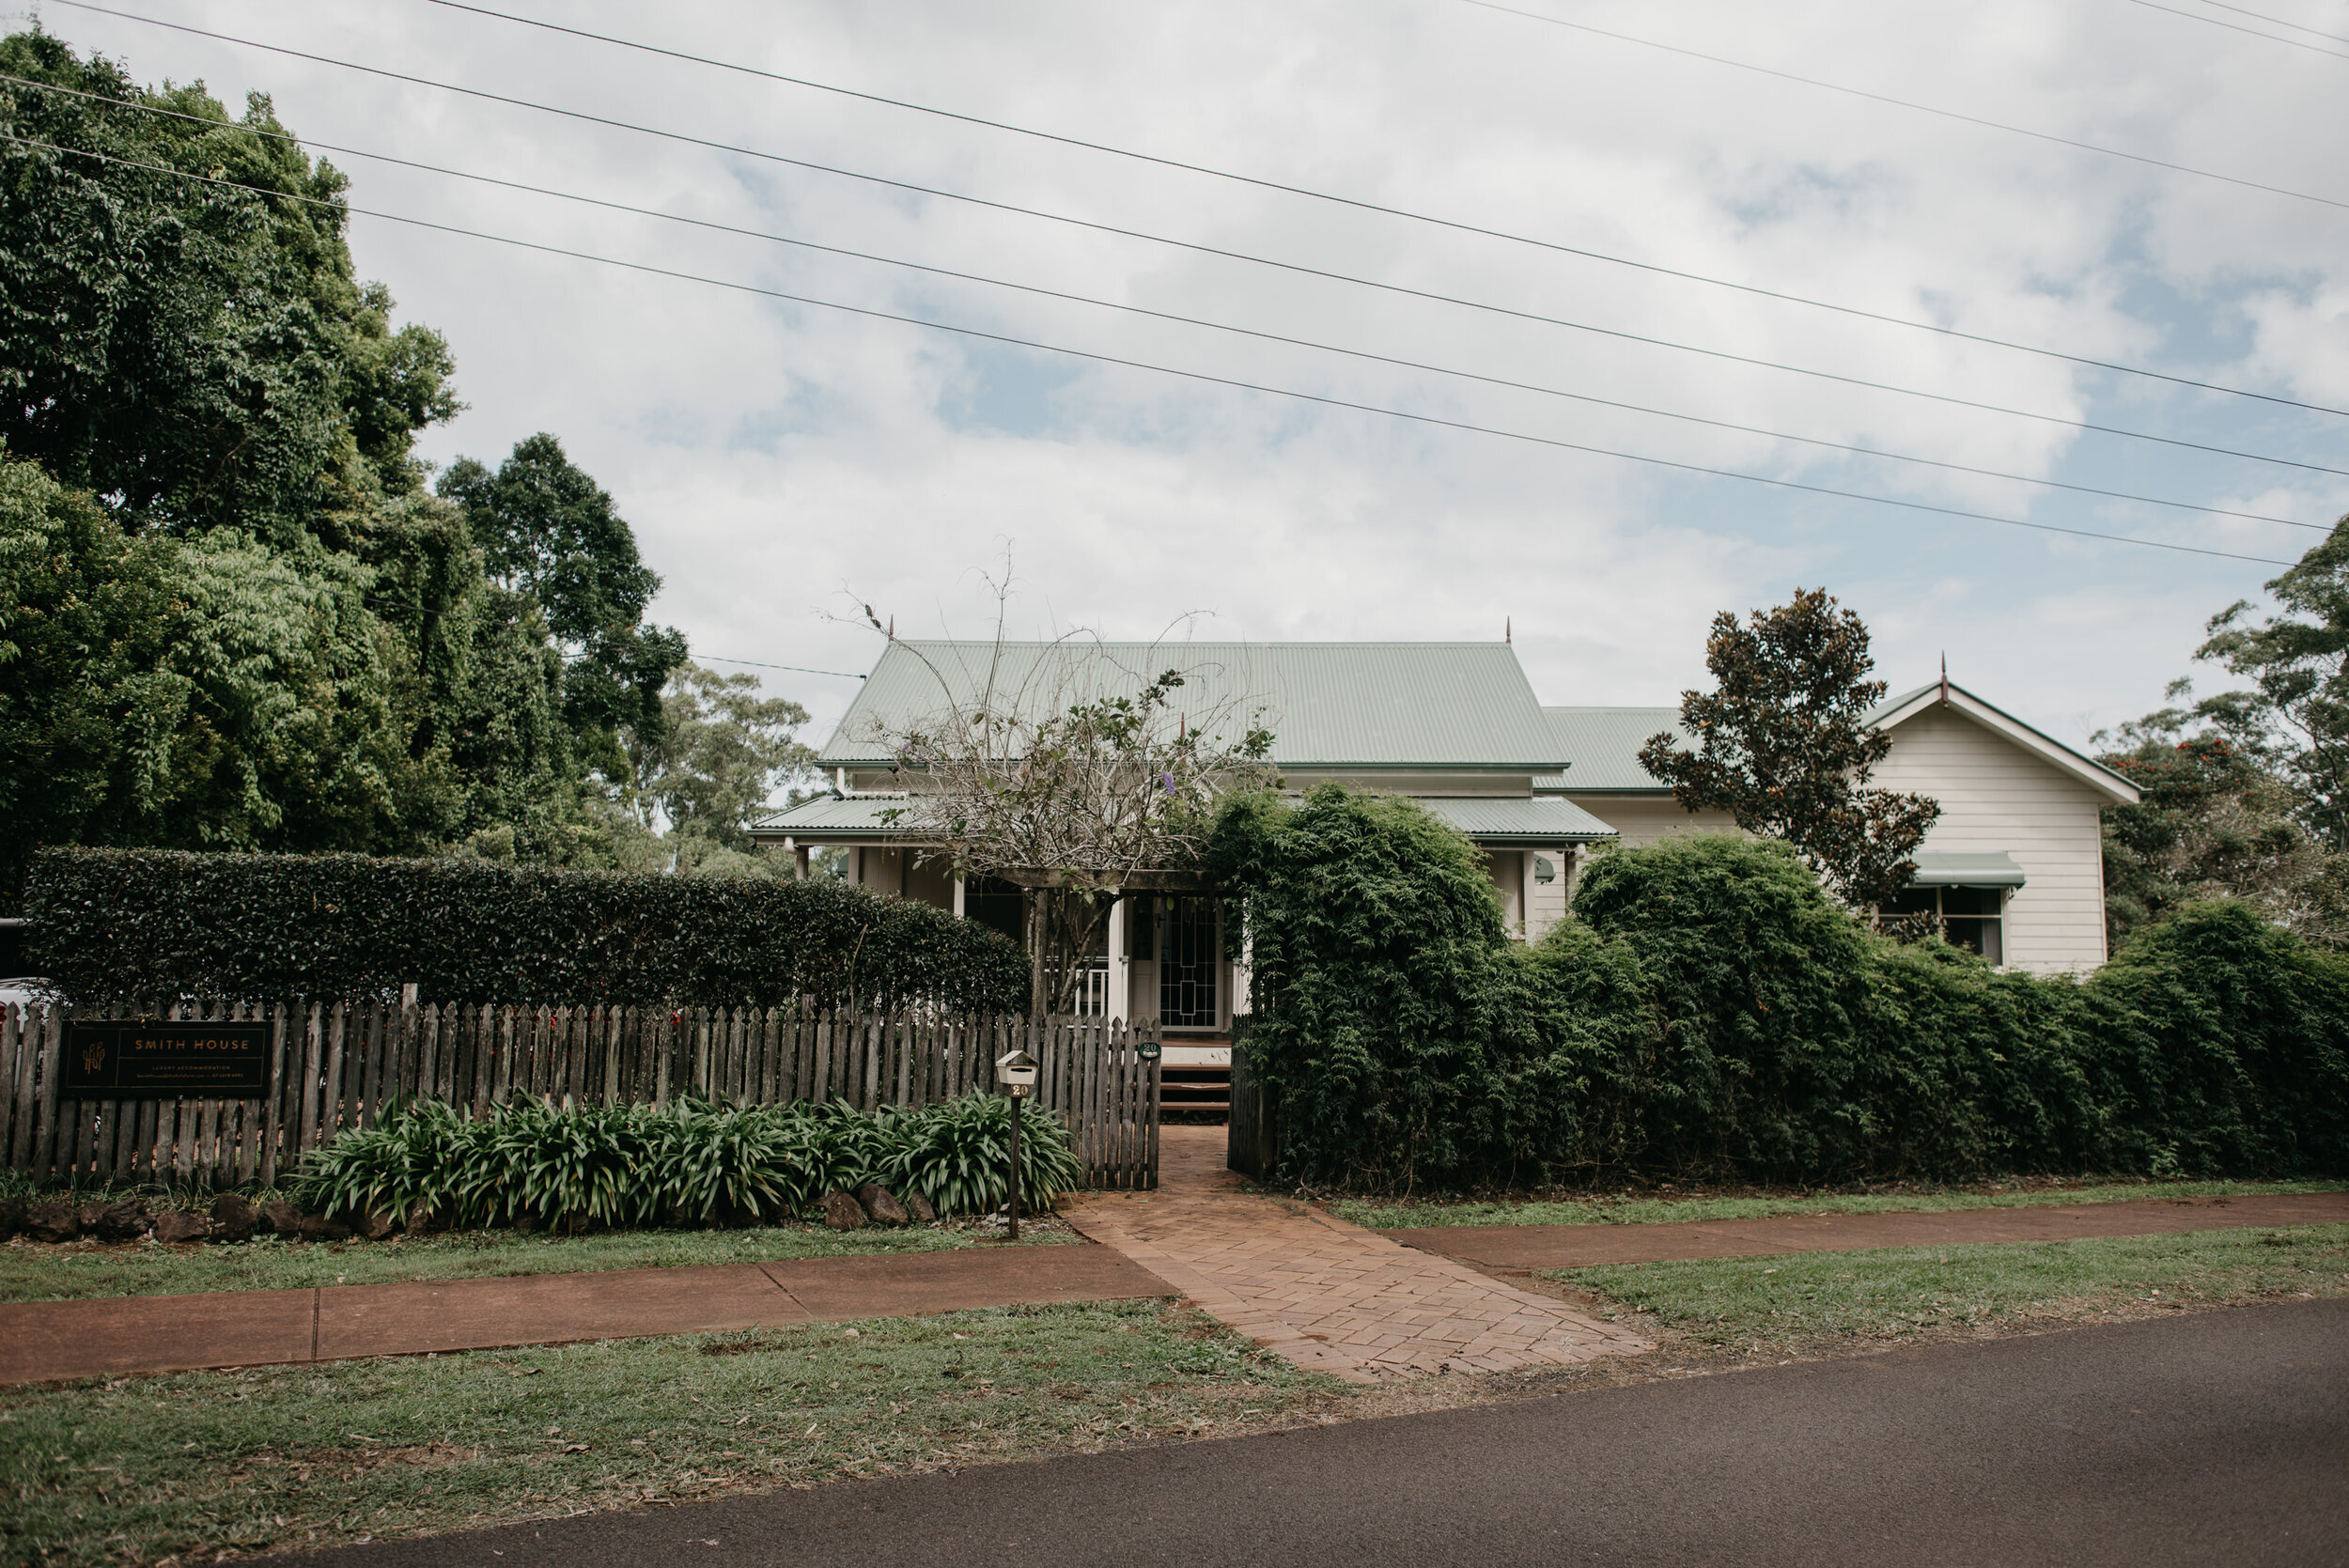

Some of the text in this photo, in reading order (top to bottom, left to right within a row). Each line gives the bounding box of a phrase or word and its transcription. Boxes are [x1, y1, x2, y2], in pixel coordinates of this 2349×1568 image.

[134, 1039, 249, 1050] SMITH HOUSE
[1143, 1043, 1157, 1052] 20
[1013, 1084, 1028, 1095] 20
